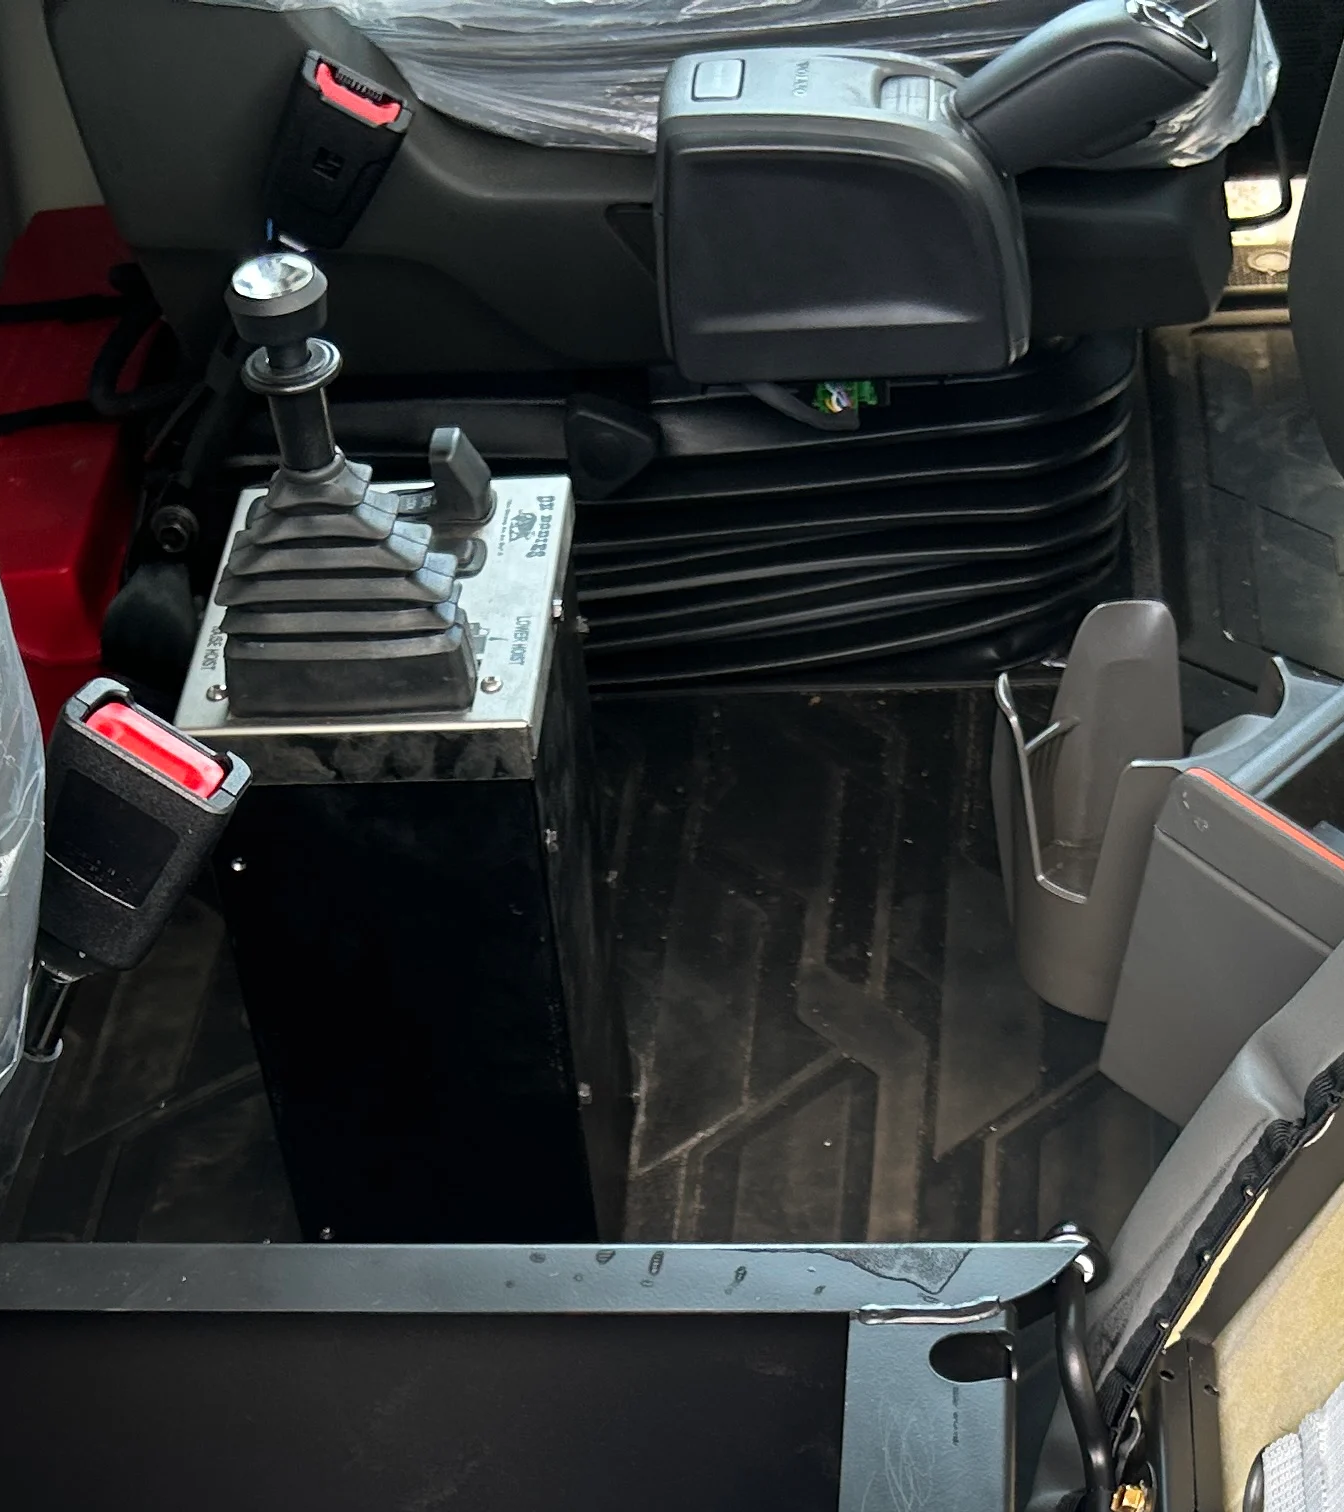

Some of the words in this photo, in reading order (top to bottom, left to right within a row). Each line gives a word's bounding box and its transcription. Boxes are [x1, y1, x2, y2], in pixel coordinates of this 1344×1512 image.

[514, 615, 532, 642] LOWER
[200, 648, 219, 670] HOIST
[509, 643, 526, 665] HOIST
